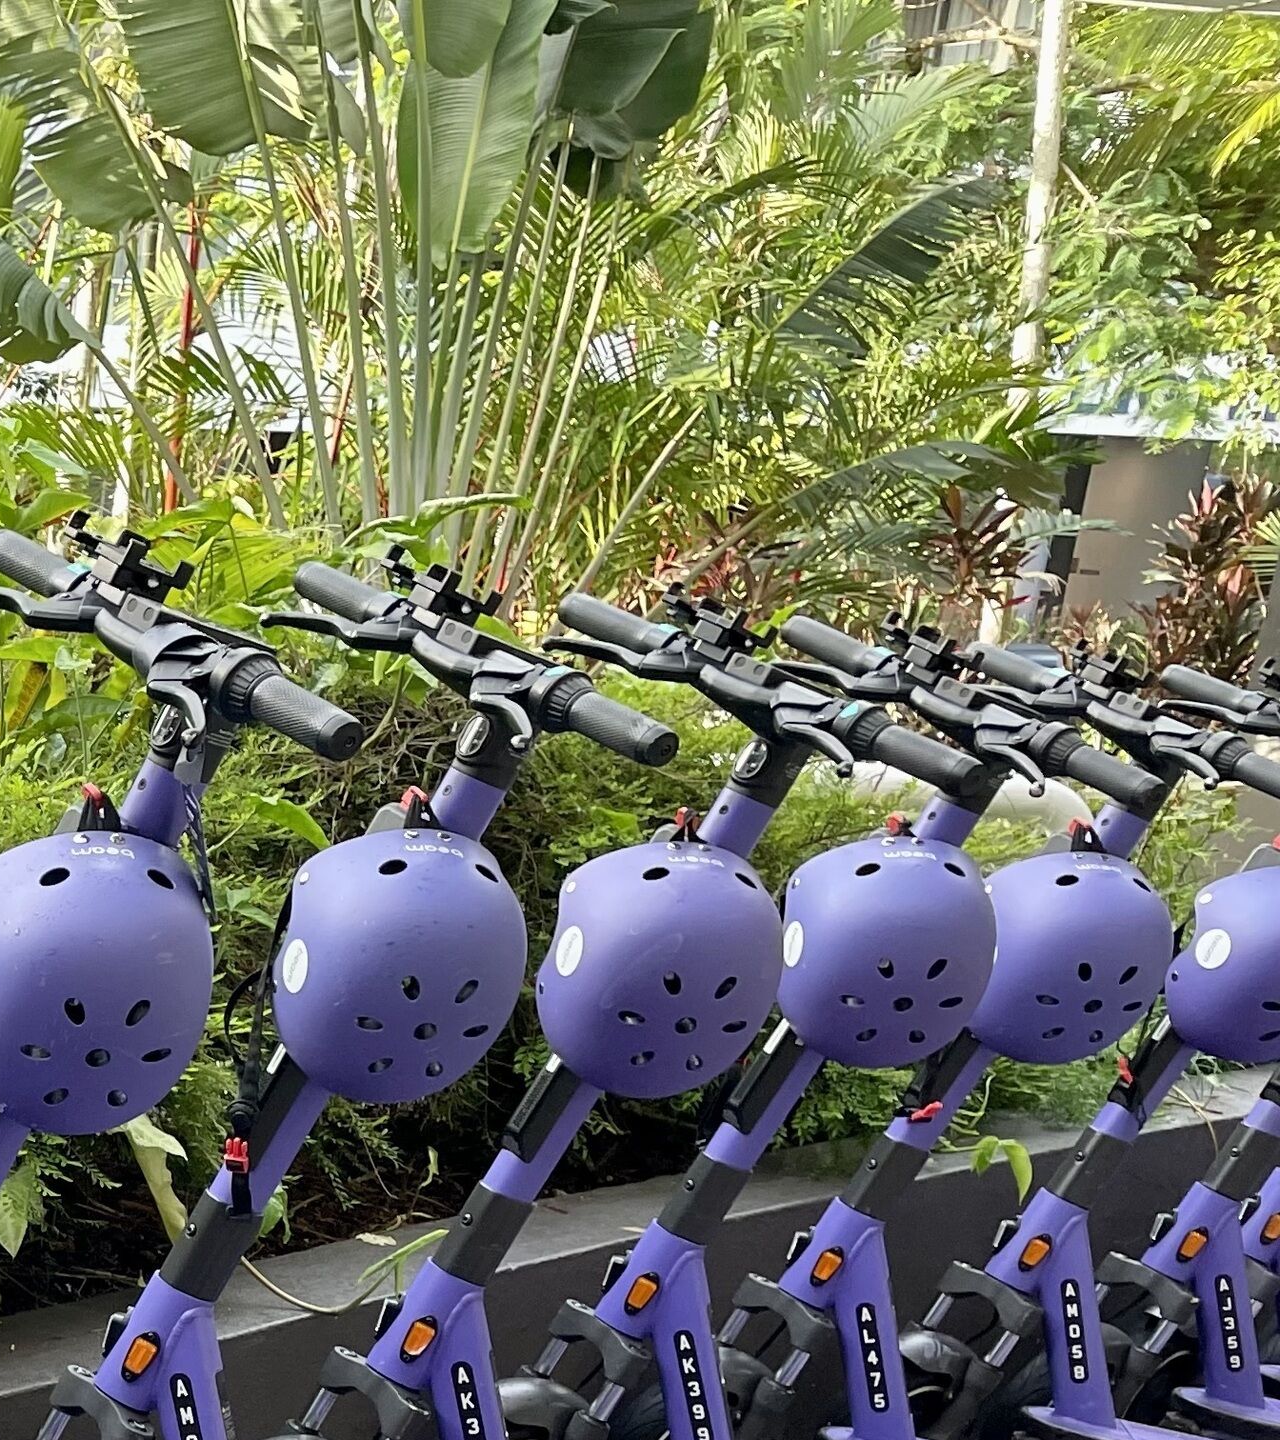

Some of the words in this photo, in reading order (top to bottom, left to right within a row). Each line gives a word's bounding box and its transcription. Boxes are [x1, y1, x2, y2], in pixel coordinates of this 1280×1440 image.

[71, 847, 135, 859] beam
[405, 844, 464, 858] beam
[861, 1306, 885, 1409] AL475
[1065, 1282, 1085, 1380] AM058
[1219, 1278, 1241, 1369] AJ359
